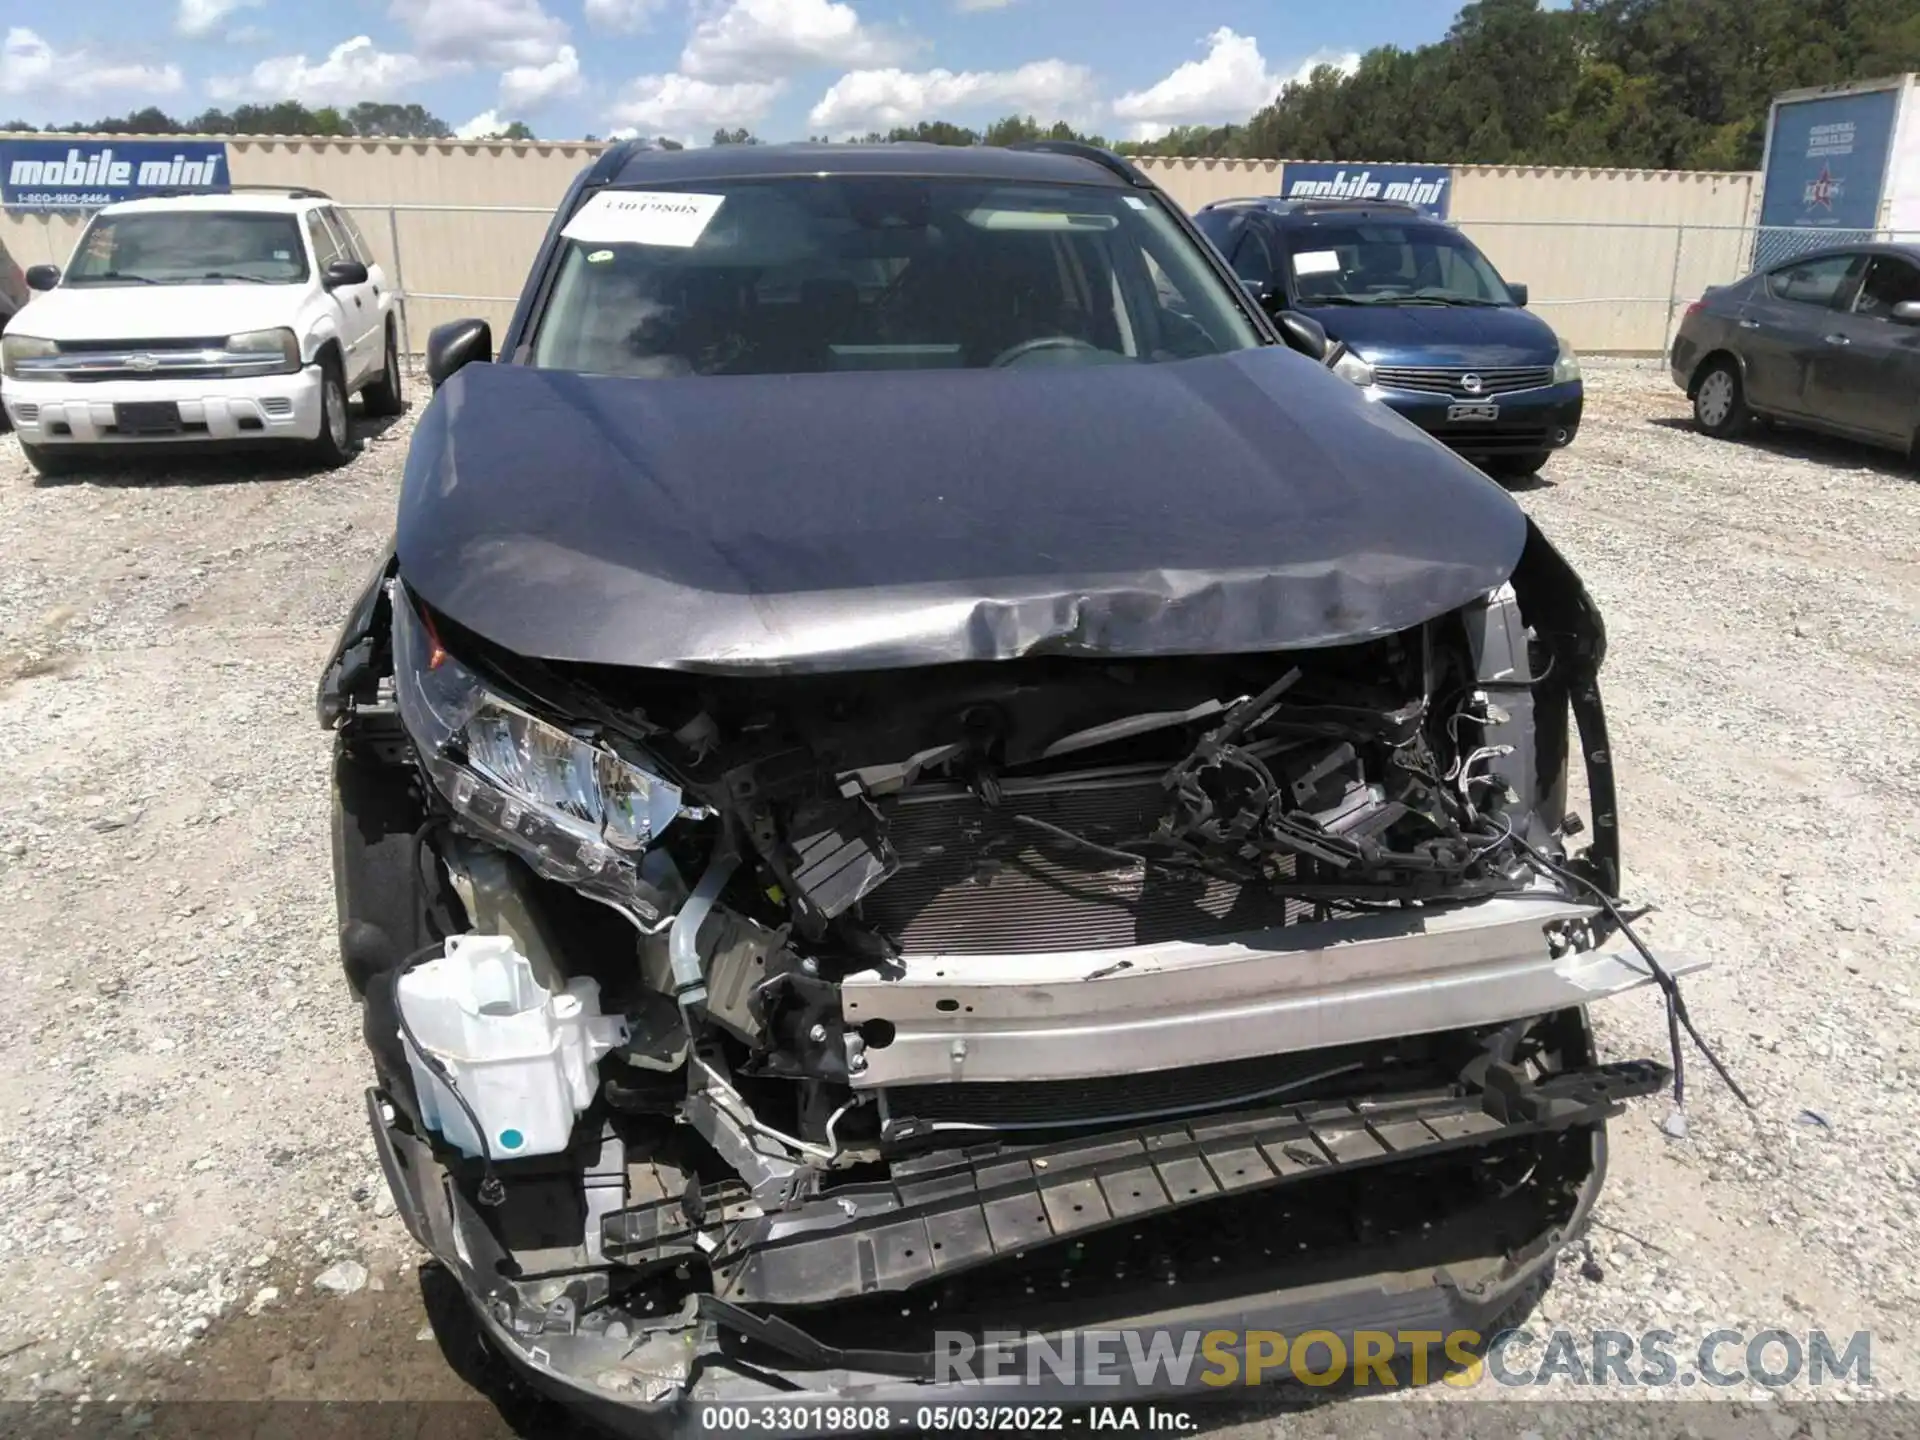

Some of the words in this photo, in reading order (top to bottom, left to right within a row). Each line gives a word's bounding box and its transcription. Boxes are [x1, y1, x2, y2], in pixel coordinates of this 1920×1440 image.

[9, 149, 131, 185] mobile
[137, 155, 217, 185] mini
[1289, 171, 1381, 200] mobile
[1383, 178, 1443, 204] mini
